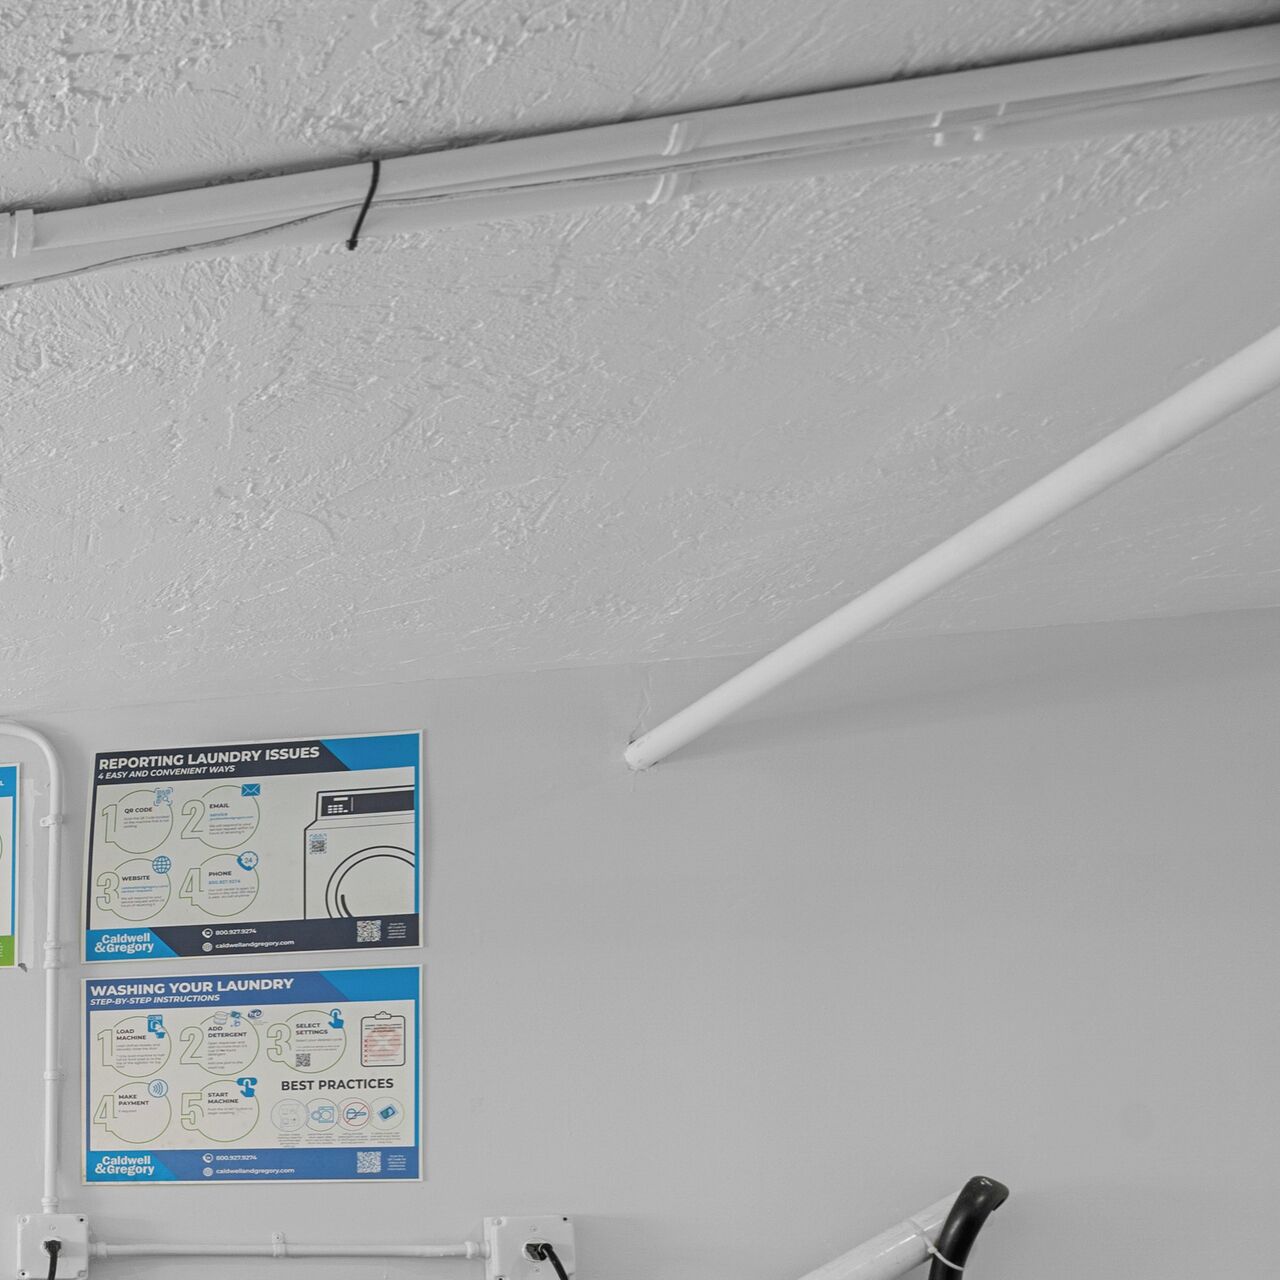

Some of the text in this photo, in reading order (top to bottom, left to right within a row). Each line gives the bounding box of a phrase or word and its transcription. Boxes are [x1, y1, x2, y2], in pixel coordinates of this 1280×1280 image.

[99, 746, 320, 770] REPORTING LAUNDRY ISSUES
[106, 771, 127, 779] EASY
[150, 767, 208, 777] CONVENIENT
[209, 765, 235, 773] WAYS
[102, 933, 150, 944] Caldwell
[95, 942, 154, 953] &Gregory
[215, 939, 295, 950] caldwellandgregory.com
[91, 979, 294, 996] WASHING YOUR LAUNDRY
[90, 994, 220, 1005] STEP-BY-STEP INSTRUCTIONS
[282, 1079, 394, 1091] BEST PRACTICES
[102, 1156, 151, 1165] Caldwell
[95, 1163, 154, 1175] &Gregory
[215, 1166, 295, 1177] caldwellandgregory.com
